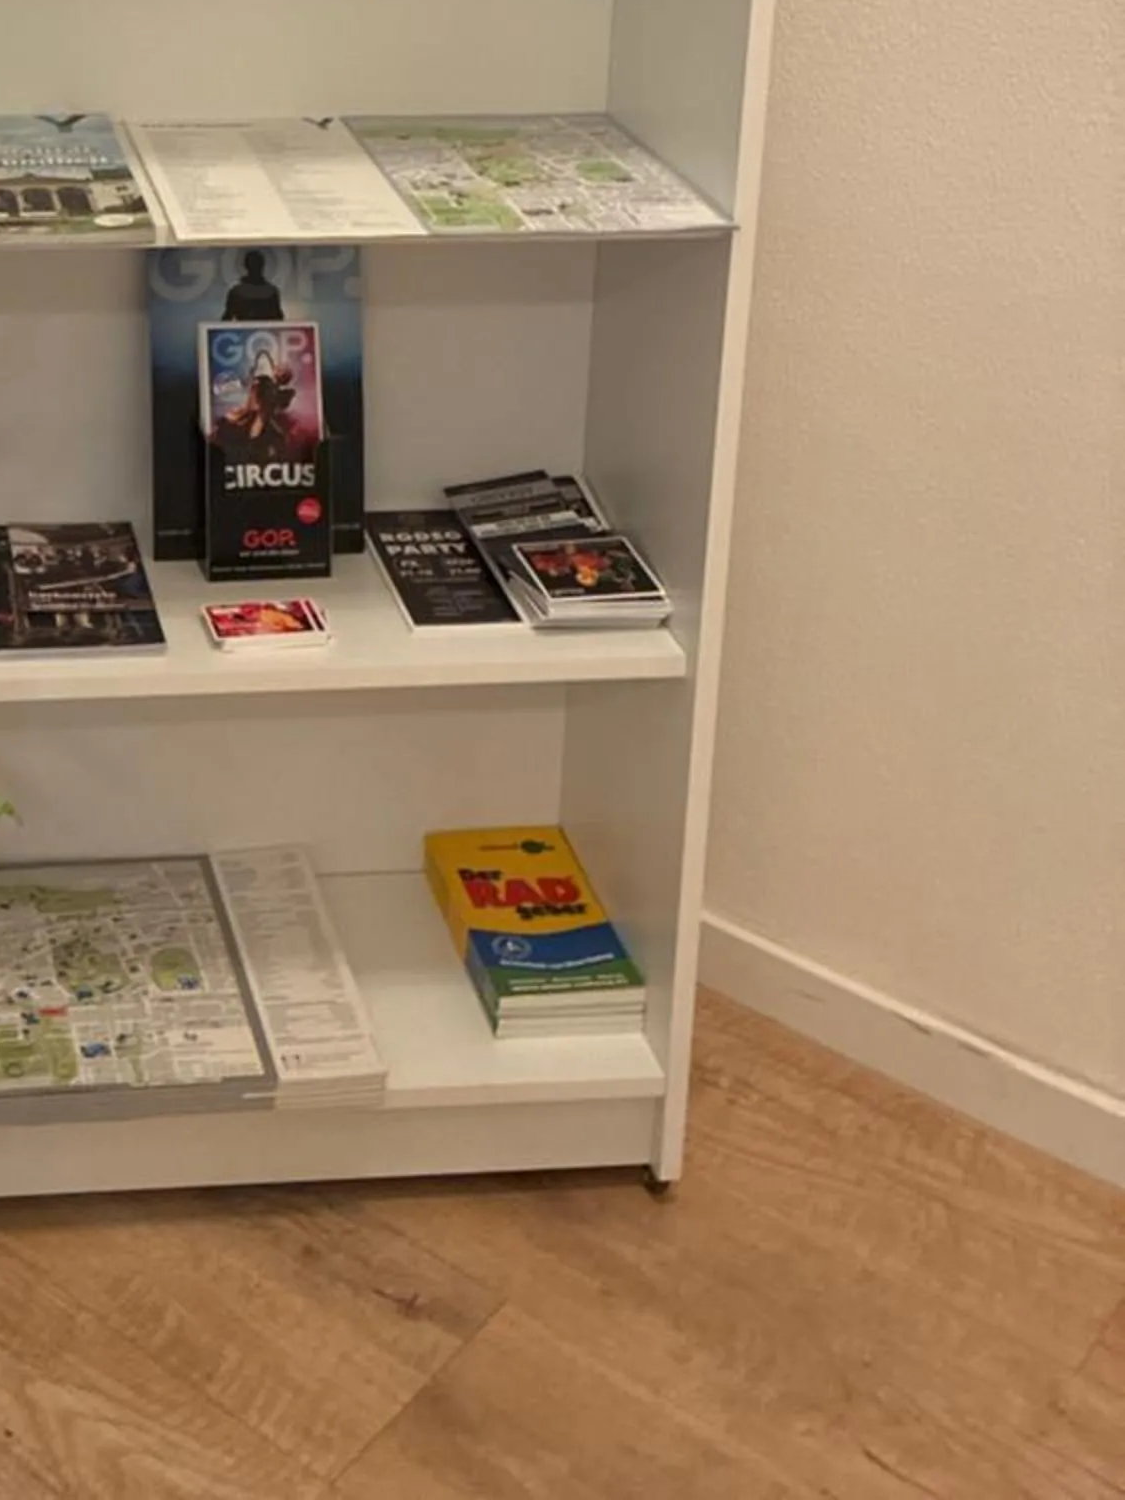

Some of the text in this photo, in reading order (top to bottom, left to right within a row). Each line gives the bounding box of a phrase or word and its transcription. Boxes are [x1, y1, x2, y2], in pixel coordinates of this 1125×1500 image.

[212, 331, 312, 366] GOP.
[242, 529, 297, 549] GOP.
[378, 531, 462, 543] RODEO
[385, 543, 467, 556] PARTY
[462, 875, 581, 909] RAD
